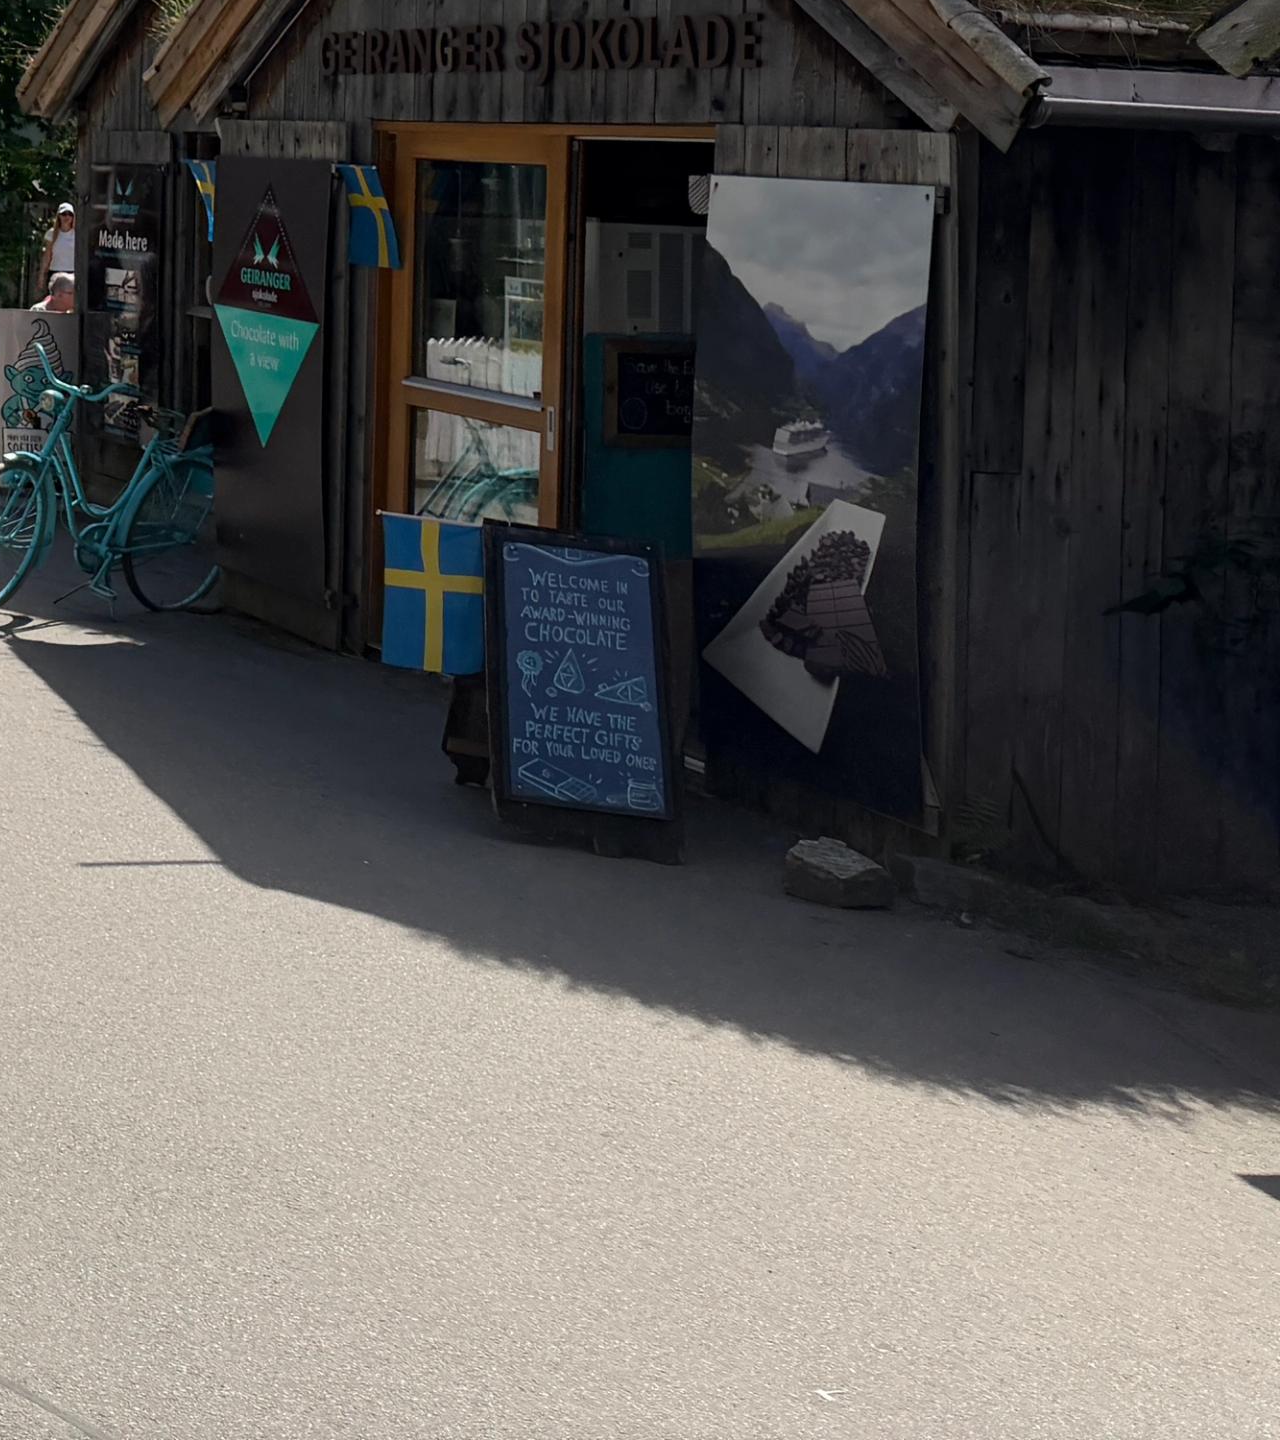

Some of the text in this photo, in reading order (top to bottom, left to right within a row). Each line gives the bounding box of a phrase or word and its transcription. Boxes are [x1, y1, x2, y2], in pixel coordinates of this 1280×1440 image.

[320, 12, 766, 86] GEIRANGER SJOKOLADE
[98, 229, 148, 252] Made here
[240, 267, 291, 291] GEIRANGER
[230, 320, 300, 351] Chocolate with
[249, 352, 279, 371] a view
[528, 567, 628, 595] WELCOME IN
[521, 587, 625, 613] TO TASTE OUR
[524, 622, 628, 650] CHOCOLATE
[530, 702, 637, 731] WE HAVE THE
[525, 720, 642, 751] PERFECT GIFTS
[512, 737, 657, 771] FOR YOUR LOVED ONES
